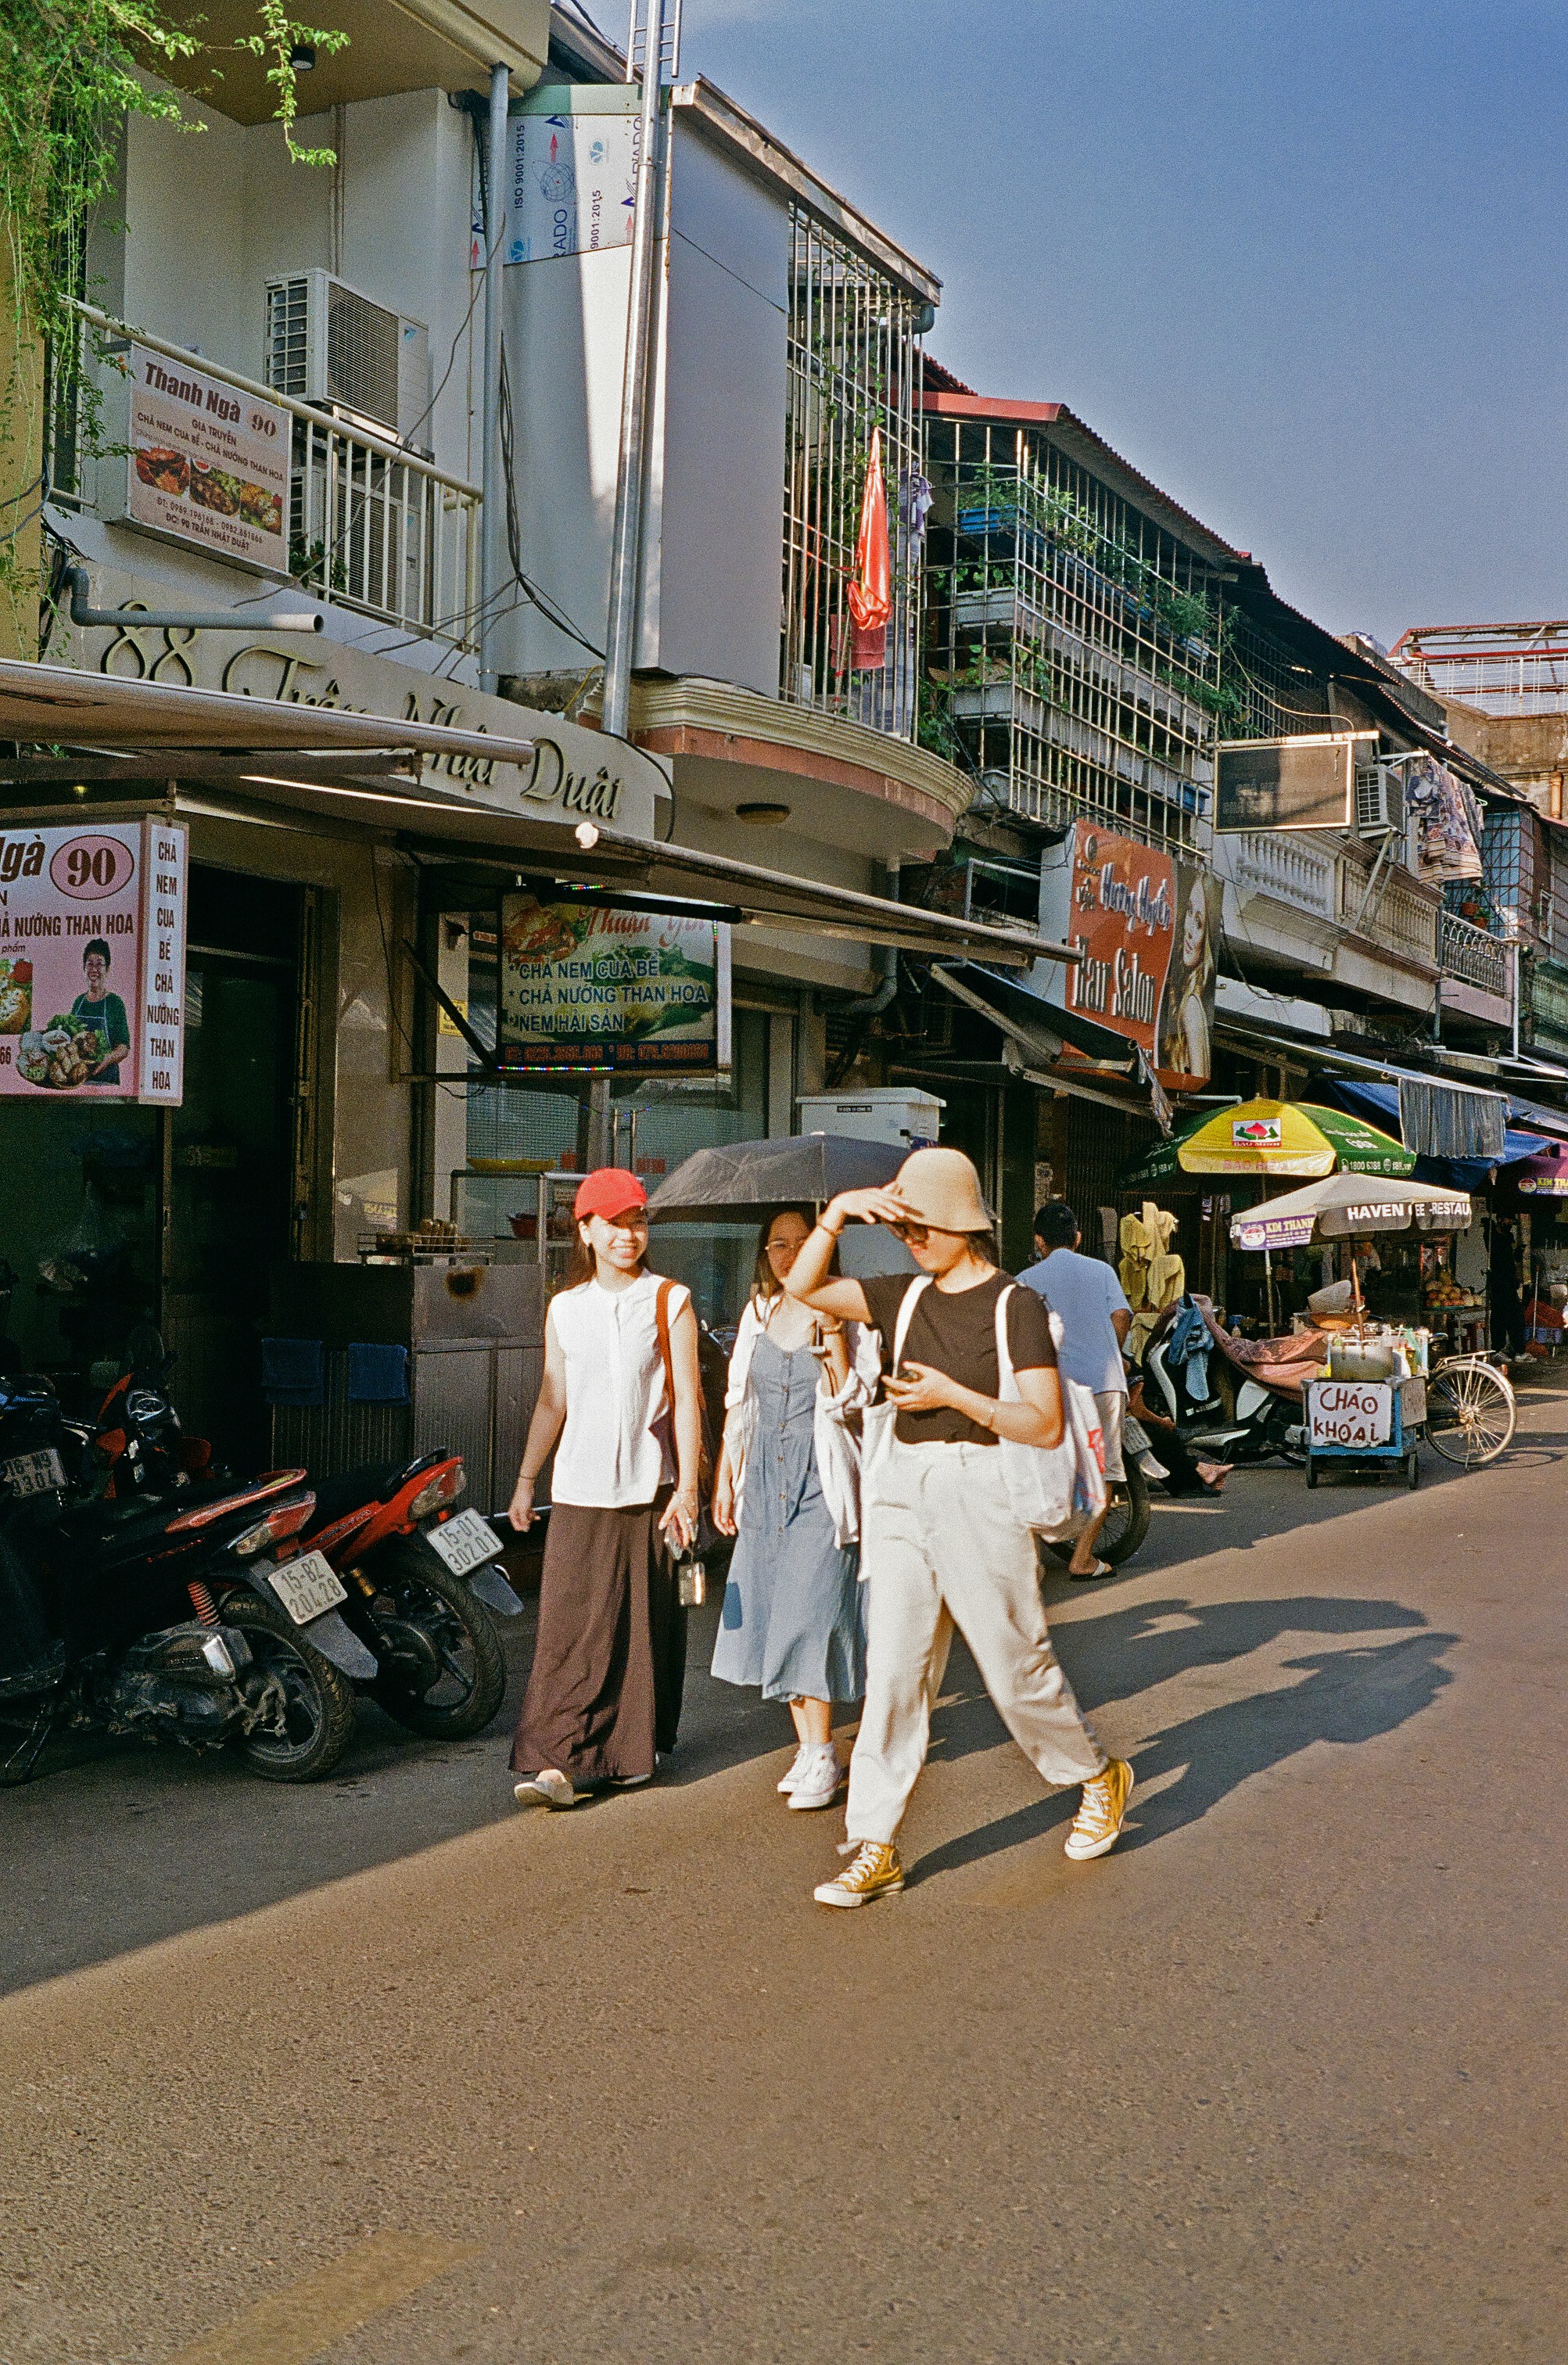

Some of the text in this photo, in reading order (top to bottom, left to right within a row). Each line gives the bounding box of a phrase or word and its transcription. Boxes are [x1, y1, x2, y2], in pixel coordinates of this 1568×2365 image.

[515, 124, 525, 209] ISO 9001:2015
[590, 190, 601, 249] 9001:2015
[145, 361, 203, 407] Thanh
[206, 390, 241, 423] Ngà
[192, 418, 206, 432] GIA
[157, 420, 173, 433] NEM
[174, 428, 190, 441] CUA
[250, 460, 267, 476] THAN
[269, 468, 284, 482] HOA
[158, 838, 177, 863] CHẢ
[67, 849, 116, 887] 90
[156, 874, 177, 895] NEM
[14, 912, 61, 937] NƯỚNG
[65, 914, 102, 935] THAN
[106, 913, 134, 934] HOA
[156, 906, 174, 928] CUA
[155, 969, 174, 994] CHẢ
[558, 962, 592, 978] NEM
[597, 960, 632, 978] CUA
[519, 982, 552, 1004] CHẢ
[621, 985, 665, 1003] THAN
[670, 985, 709, 1003] HOA
[1111, 948, 1154, 1023] Salon
[146, 1003, 179, 1026] NƯỚNG
[519, 1007, 625, 1032] NEM HẢI SẢN
[150, 1037, 174, 1058] THAN
[152, 1071, 170, 1090] HOA
[1347, 1203, 1405, 1220] HAVEN
[1319, 1387, 1379, 1415] CHÁO
